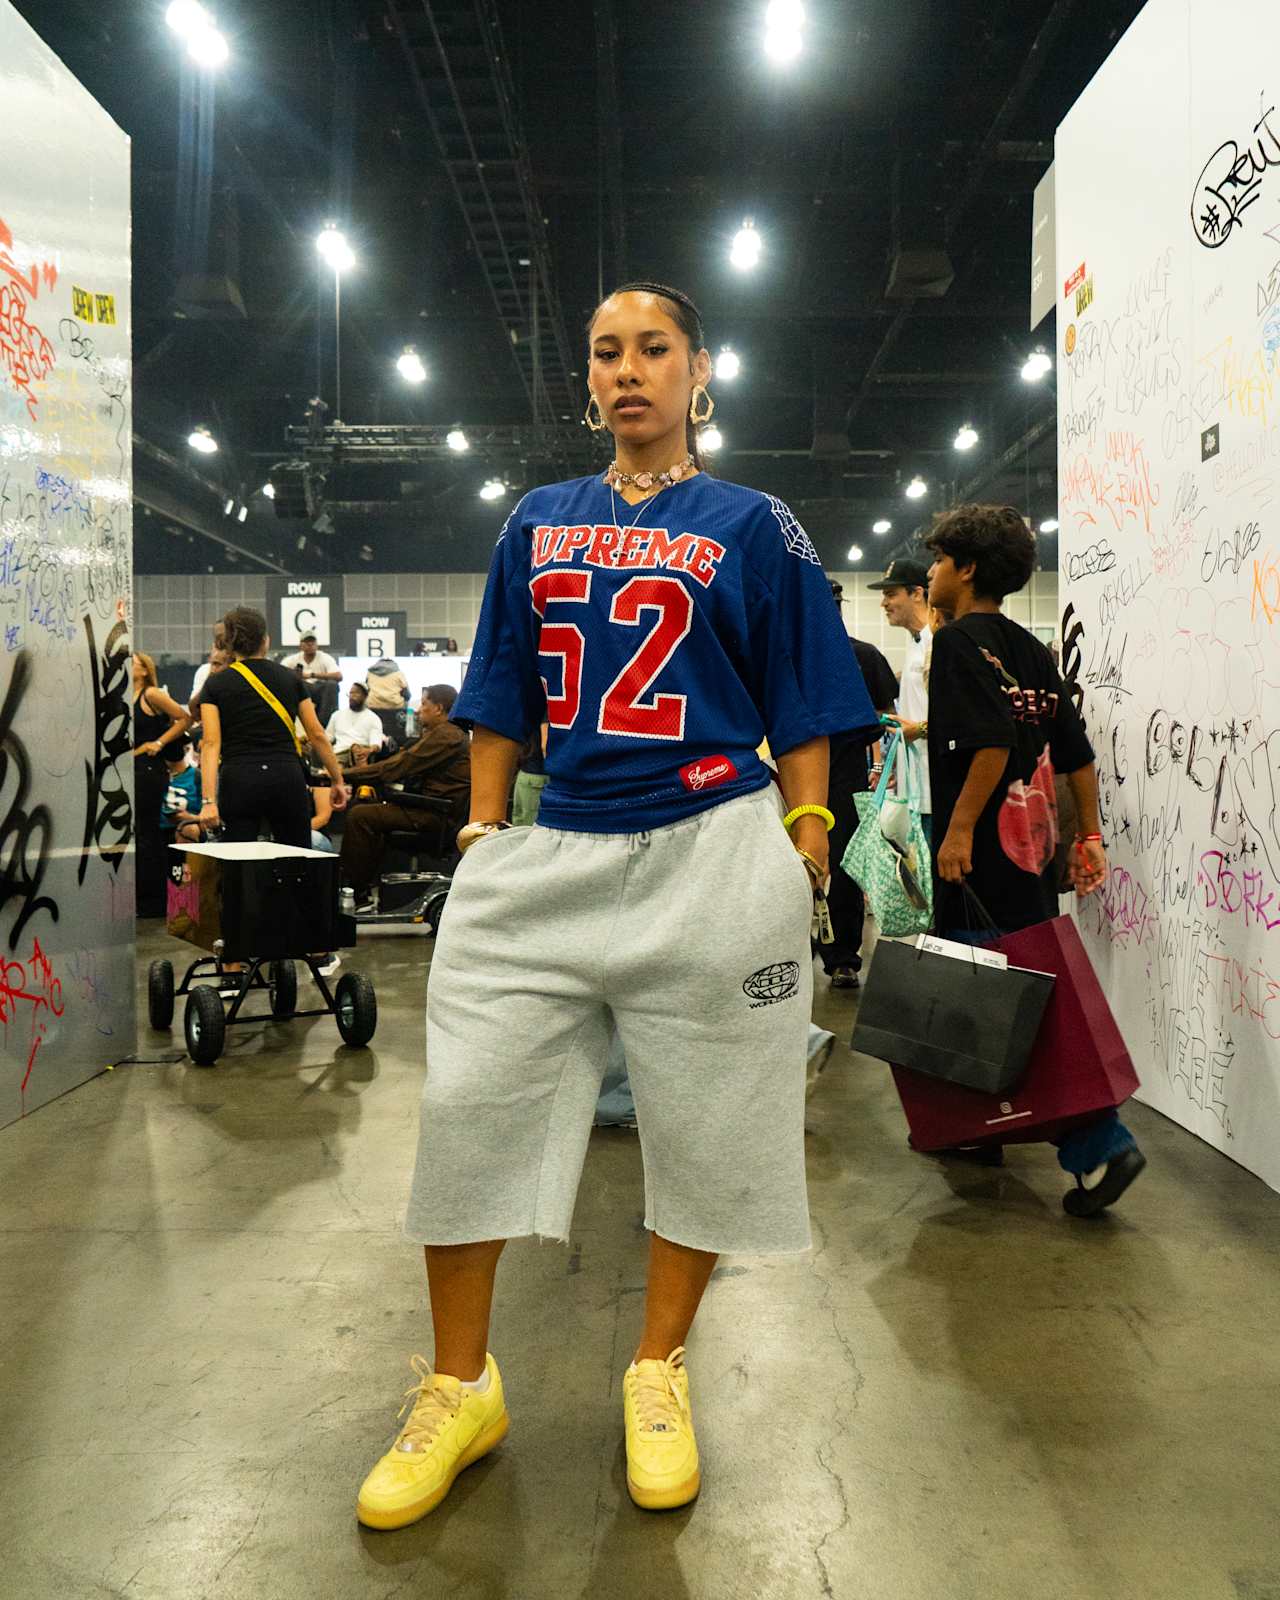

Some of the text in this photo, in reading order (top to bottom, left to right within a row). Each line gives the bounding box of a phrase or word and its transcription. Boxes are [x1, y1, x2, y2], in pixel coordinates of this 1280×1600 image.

[531, 524, 727, 589] UPREME
[287, 582, 322, 595] ROW
[294, 608, 316, 634] C
[361, 617, 390, 628] ROW
[368, 638, 384, 657] B
[528, 568, 694, 741] 52
[688, 763, 728, 791] Supreme
